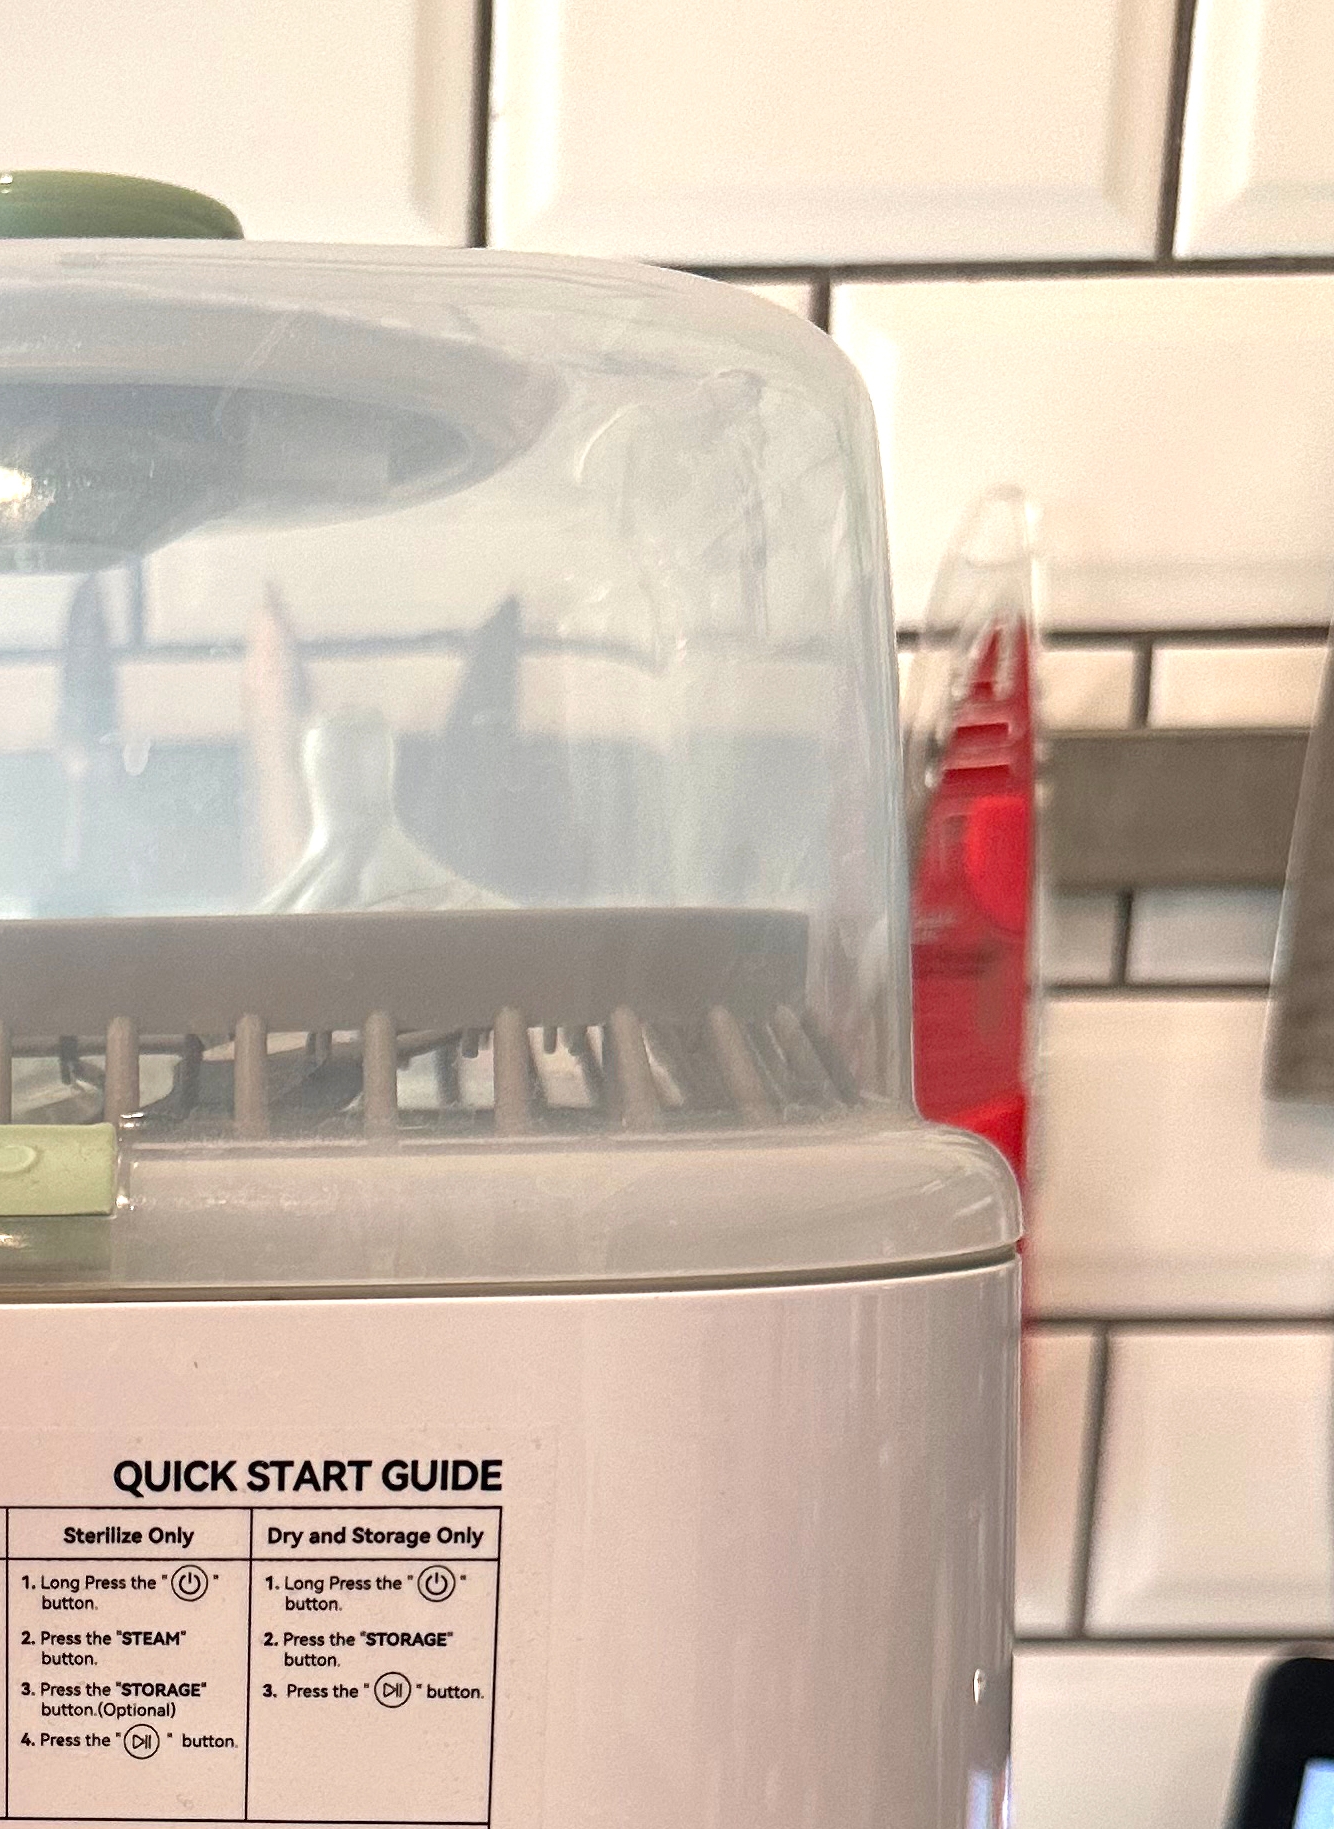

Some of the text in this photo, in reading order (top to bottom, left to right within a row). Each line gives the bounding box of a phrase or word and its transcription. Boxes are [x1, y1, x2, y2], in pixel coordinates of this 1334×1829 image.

[113, 1459, 503, 1498] QUICK START GUIDE
[63, 1526, 194, 1549] Sterilize Only
[268, 1526, 484, 1549] Dry and Storage Only
[21, 1630, 186, 1646] 2. Press the "STEAM"
[261, 1631, 453, 1647] 2. Press the "STORAGE"
[21, 1681, 207, 1697] 3. Press the "STORAGE"
[262, 1684, 484, 1699] 3. Press the button.
[20, 1733, 238, 1748] 4. Press the button.
